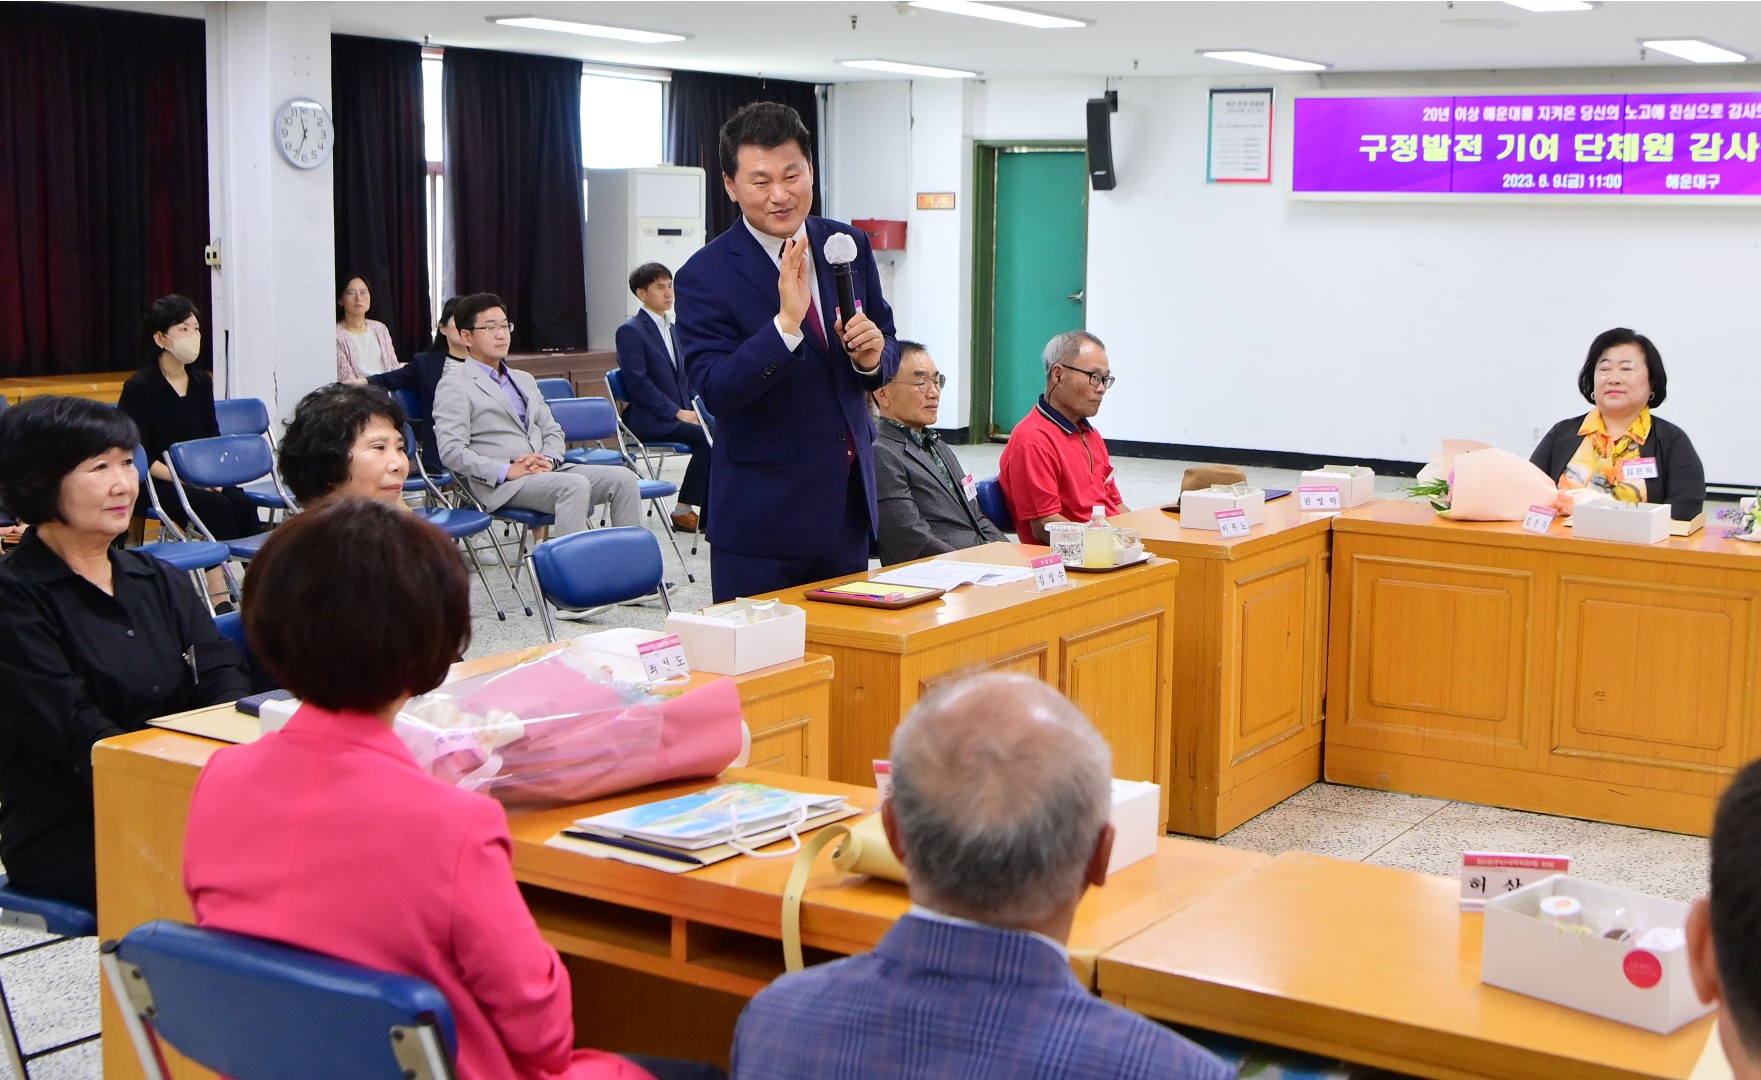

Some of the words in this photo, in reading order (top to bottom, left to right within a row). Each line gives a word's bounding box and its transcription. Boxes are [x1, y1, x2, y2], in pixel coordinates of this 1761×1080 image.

[291, 108, 298, 118] 11
[1422, 106, 1450, 122] 20년
[1454, 106, 1480, 122] 이상
[1483, 105, 1534, 122] 해운대를
[1580, 104, 1620, 121] 당신의
[1624, 103, 1666, 120] 노고에
[1669, 103, 1724, 120] 진심으로
[283, 117, 293, 126] 10
[317, 118, 324, 127] 2
[281, 128, 289, 138] 9
[320, 130, 327, 139] 3
[285, 141, 292, 150] 8
[317, 142, 324, 151] 4
[1359, 133, 1483, 163] 구정발전
[1496, 133, 1559, 163] 기여
[1574, 132, 1675, 163] 단체원
[1688, 131, 1761, 163] 감사
[293, 149, 299, 160] 7
[301, 154, 309, 163] 6
[311, 150, 318, 159] 5
[1502, 173, 1536, 188] 2023.
[1538, 173, 1550, 188] 6.
[1588, 174, 1623, 189] 11:00
[1665, 173, 1721, 190] 해운대구
